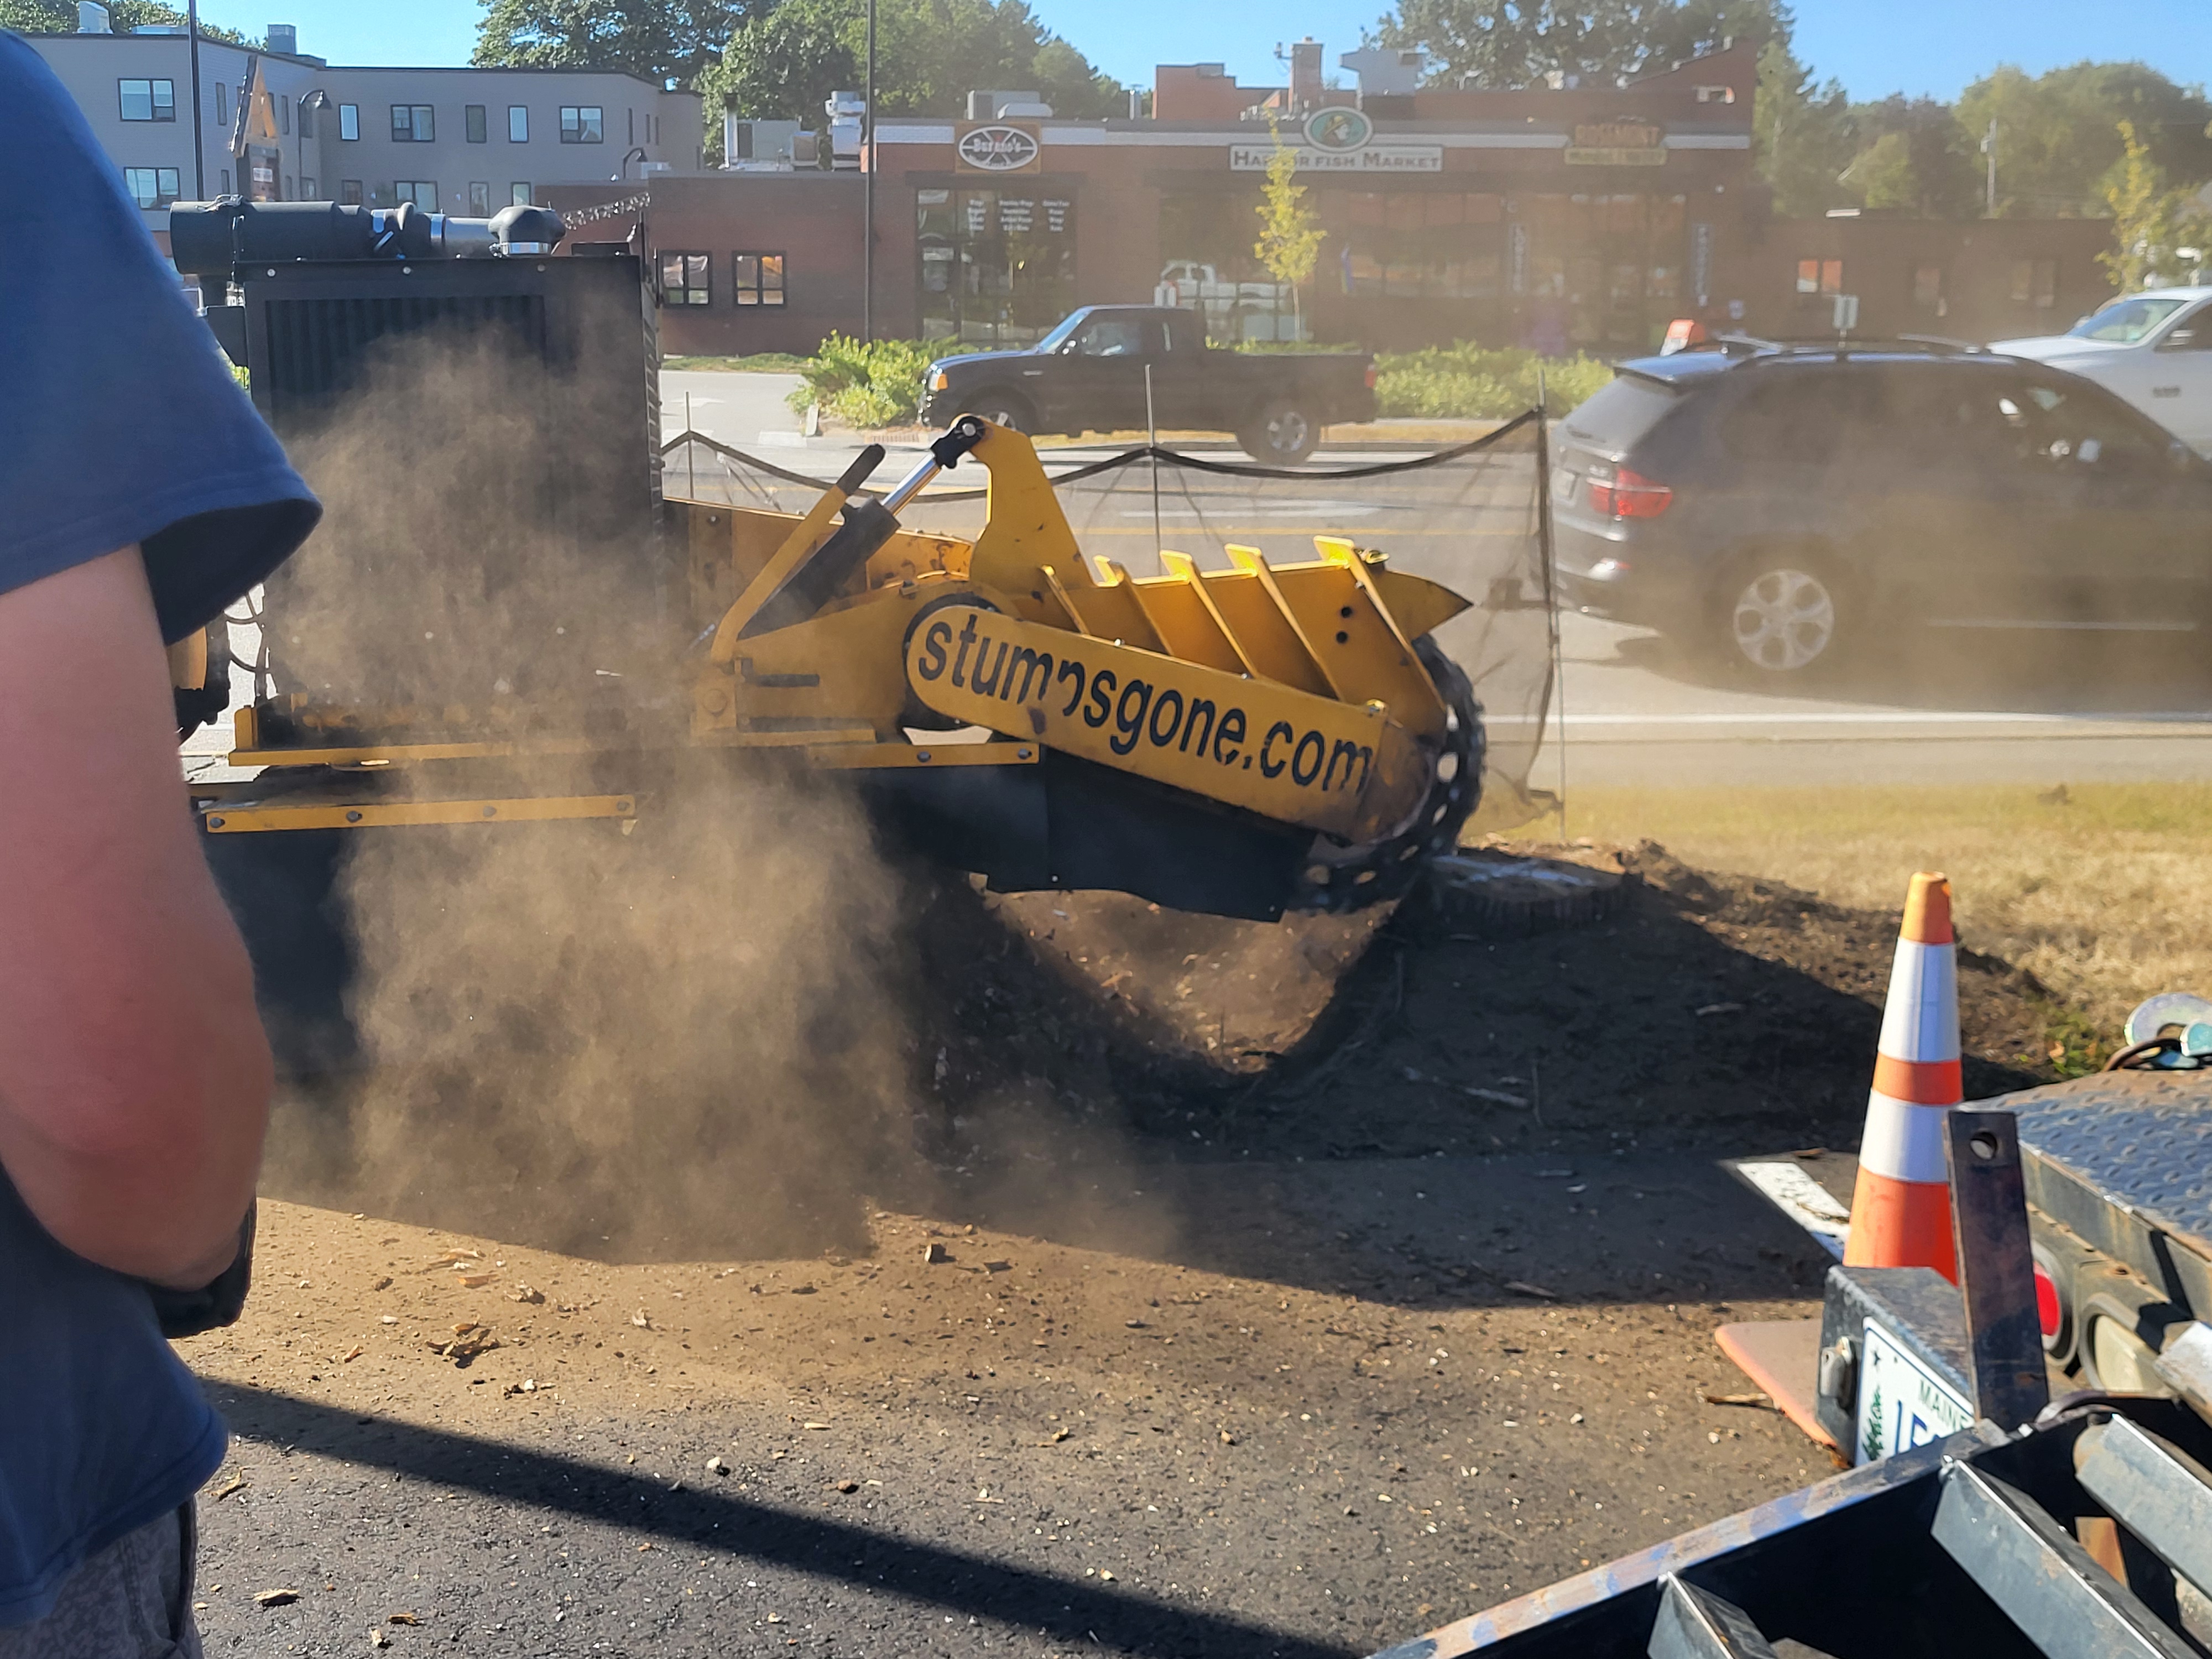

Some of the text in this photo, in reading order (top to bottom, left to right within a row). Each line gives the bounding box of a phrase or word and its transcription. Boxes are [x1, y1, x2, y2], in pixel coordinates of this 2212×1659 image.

[1234, 151, 1439, 167] HARR FISH MARKET
[919, 614, 1373, 795] stumpsgone.com
